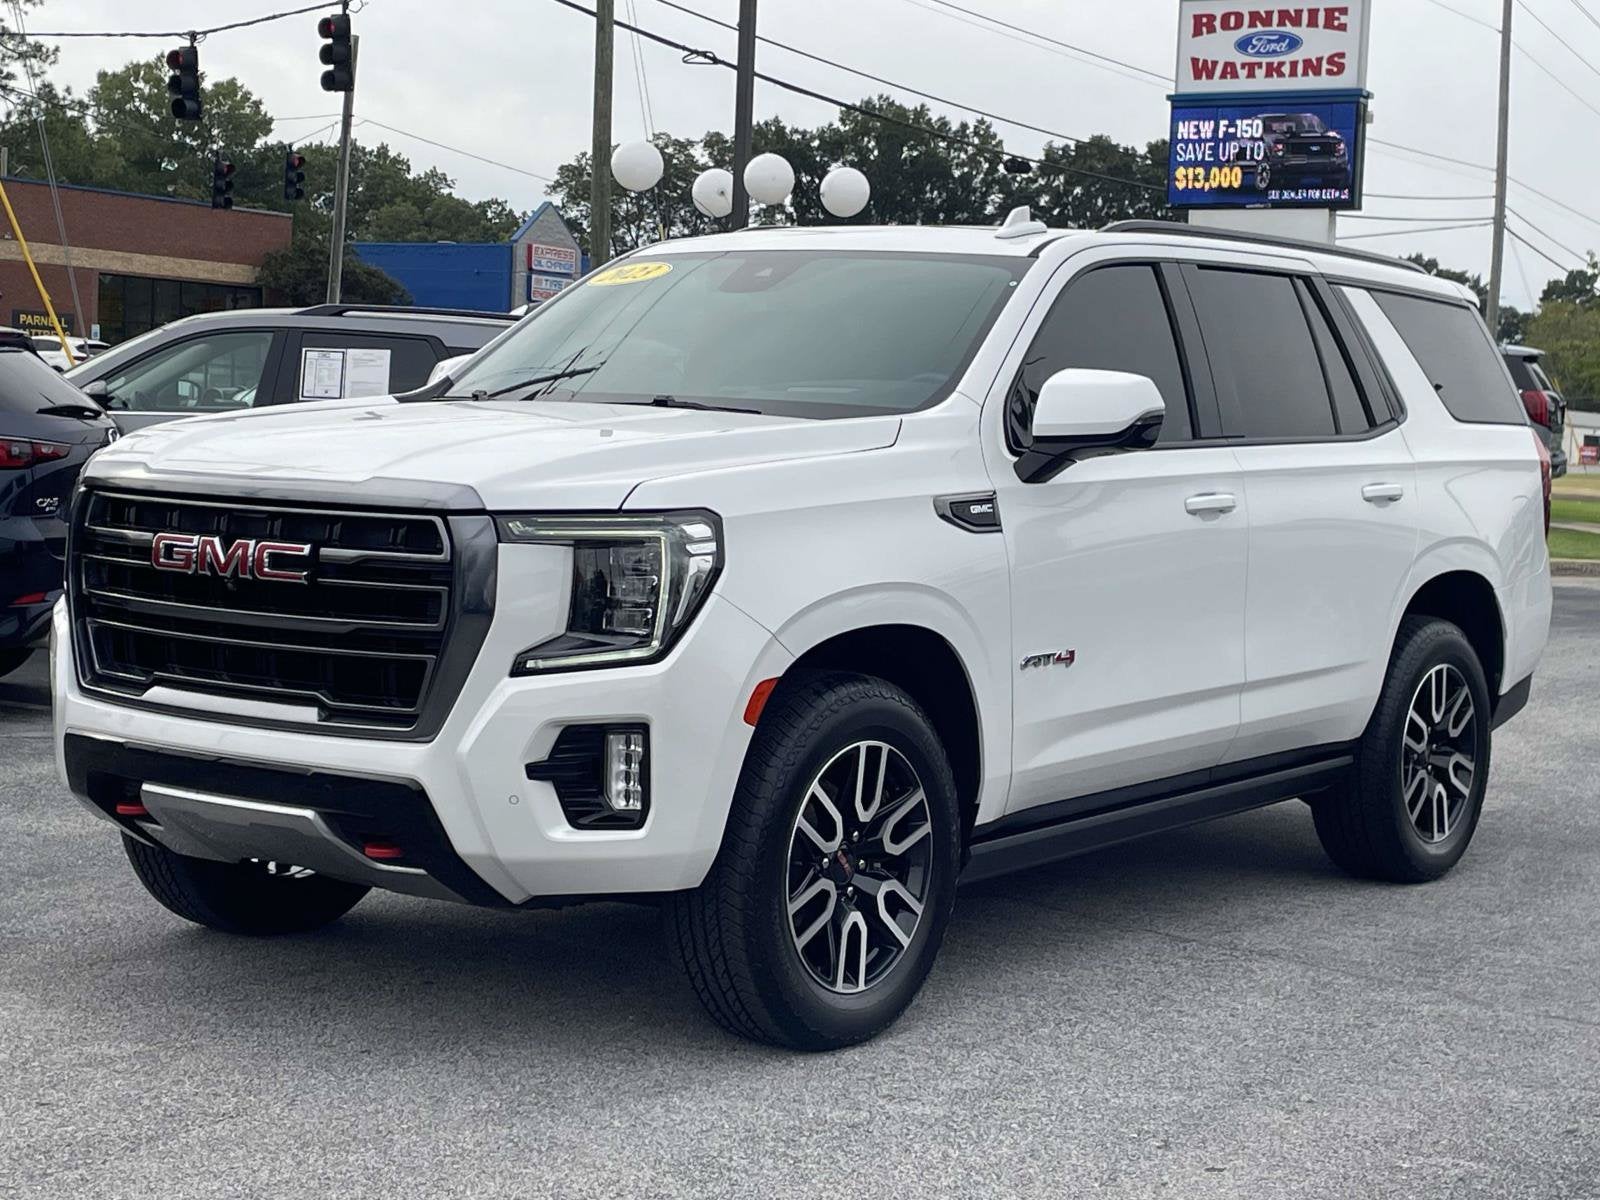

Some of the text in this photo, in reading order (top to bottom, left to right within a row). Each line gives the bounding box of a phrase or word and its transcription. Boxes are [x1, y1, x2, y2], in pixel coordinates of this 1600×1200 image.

[1192, 7, 1349, 38] RONNIE
[1247, 34, 1290, 54] Ford
[1190, 52, 1347, 81] WATKINS
[1177, 119, 1263, 140] NEW F-150
[1176, 141, 1264, 162] SAVE UP TO
[1174, 166, 1242, 192] $13,000
[534, 246, 575, 260] EXPRESS
[543, 277, 564, 290] TIRE
[19, 313, 68, 328] PARNEL
[36, 497, 59, 507] CX-5
[970, 504, 993, 513] GMC
[151, 532, 311, 585] GMC
[1020, 648, 1075, 671] AT4
